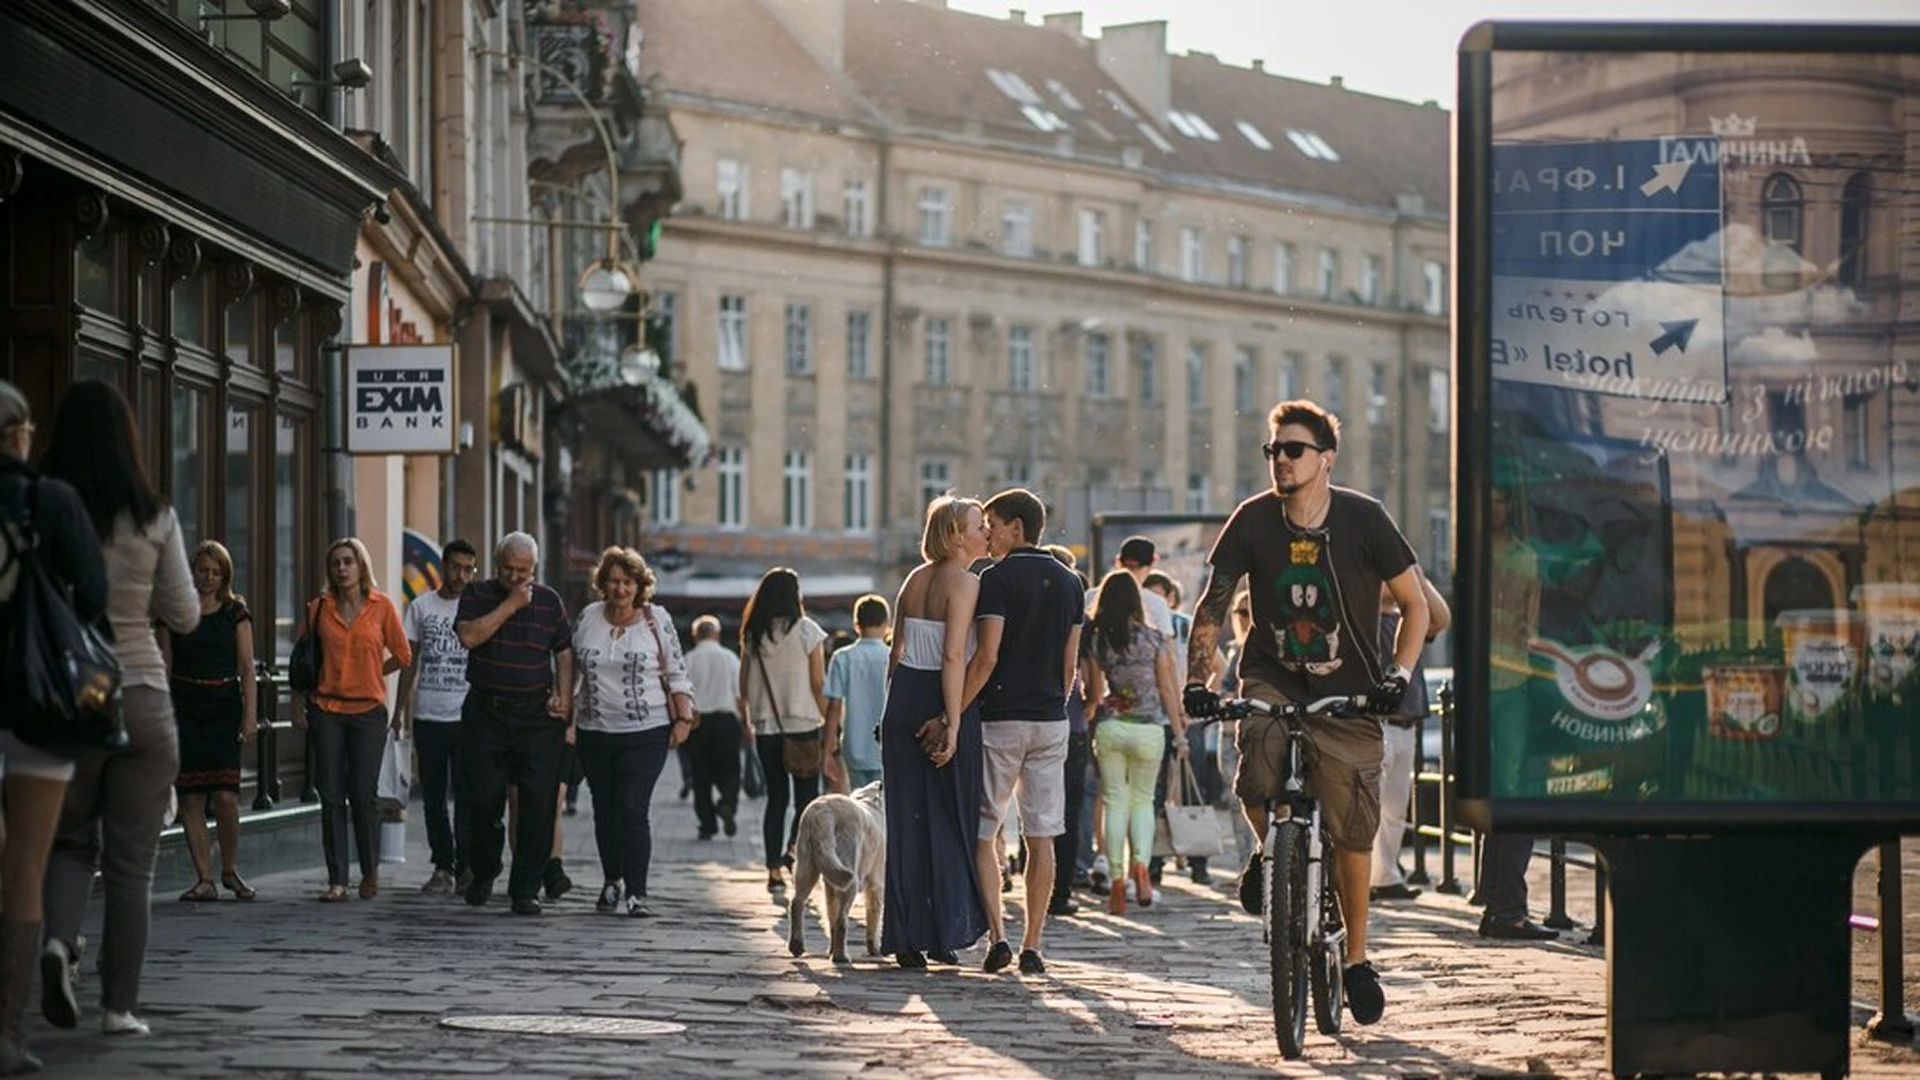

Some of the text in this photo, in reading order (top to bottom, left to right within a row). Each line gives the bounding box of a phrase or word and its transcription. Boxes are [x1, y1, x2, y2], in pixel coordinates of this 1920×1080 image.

[373, 371, 429, 381] UKR
[357, 387, 443, 412] EXIM
[356, 416, 443, 429] BANK
